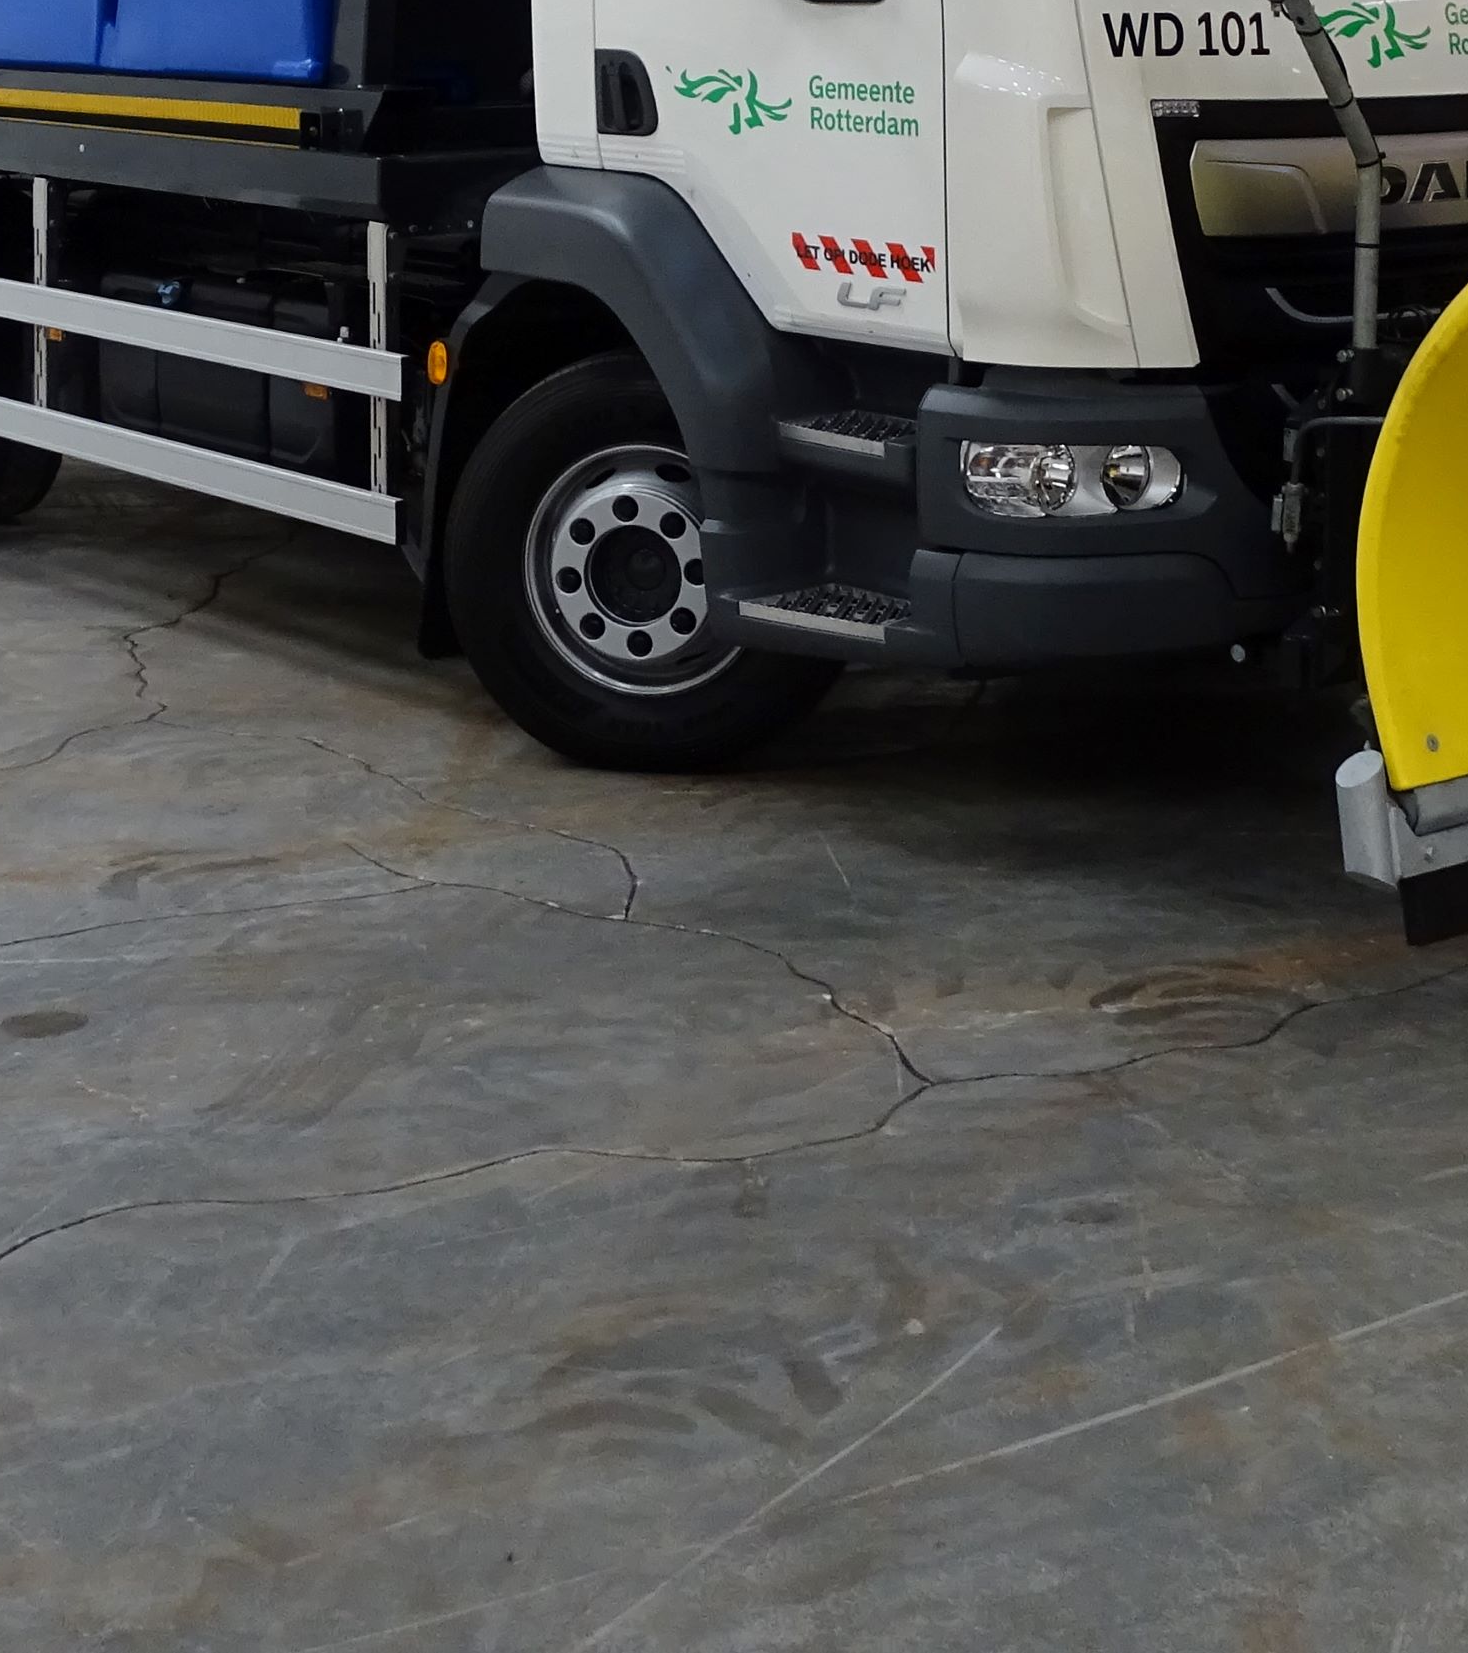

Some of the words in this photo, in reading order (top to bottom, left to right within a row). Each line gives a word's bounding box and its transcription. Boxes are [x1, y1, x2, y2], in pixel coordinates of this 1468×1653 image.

[1102, 12, 1184, 57] WD
[1198, 11, 1270, 56] 101
[809, 75, 915, 104] Gemeente
[811, 106, 919, 137] Rotterdam
[849, 250, 887, 268] DODE
[891, 255, 931, 273] HOEK
[837, 282, 906, 311] LF
